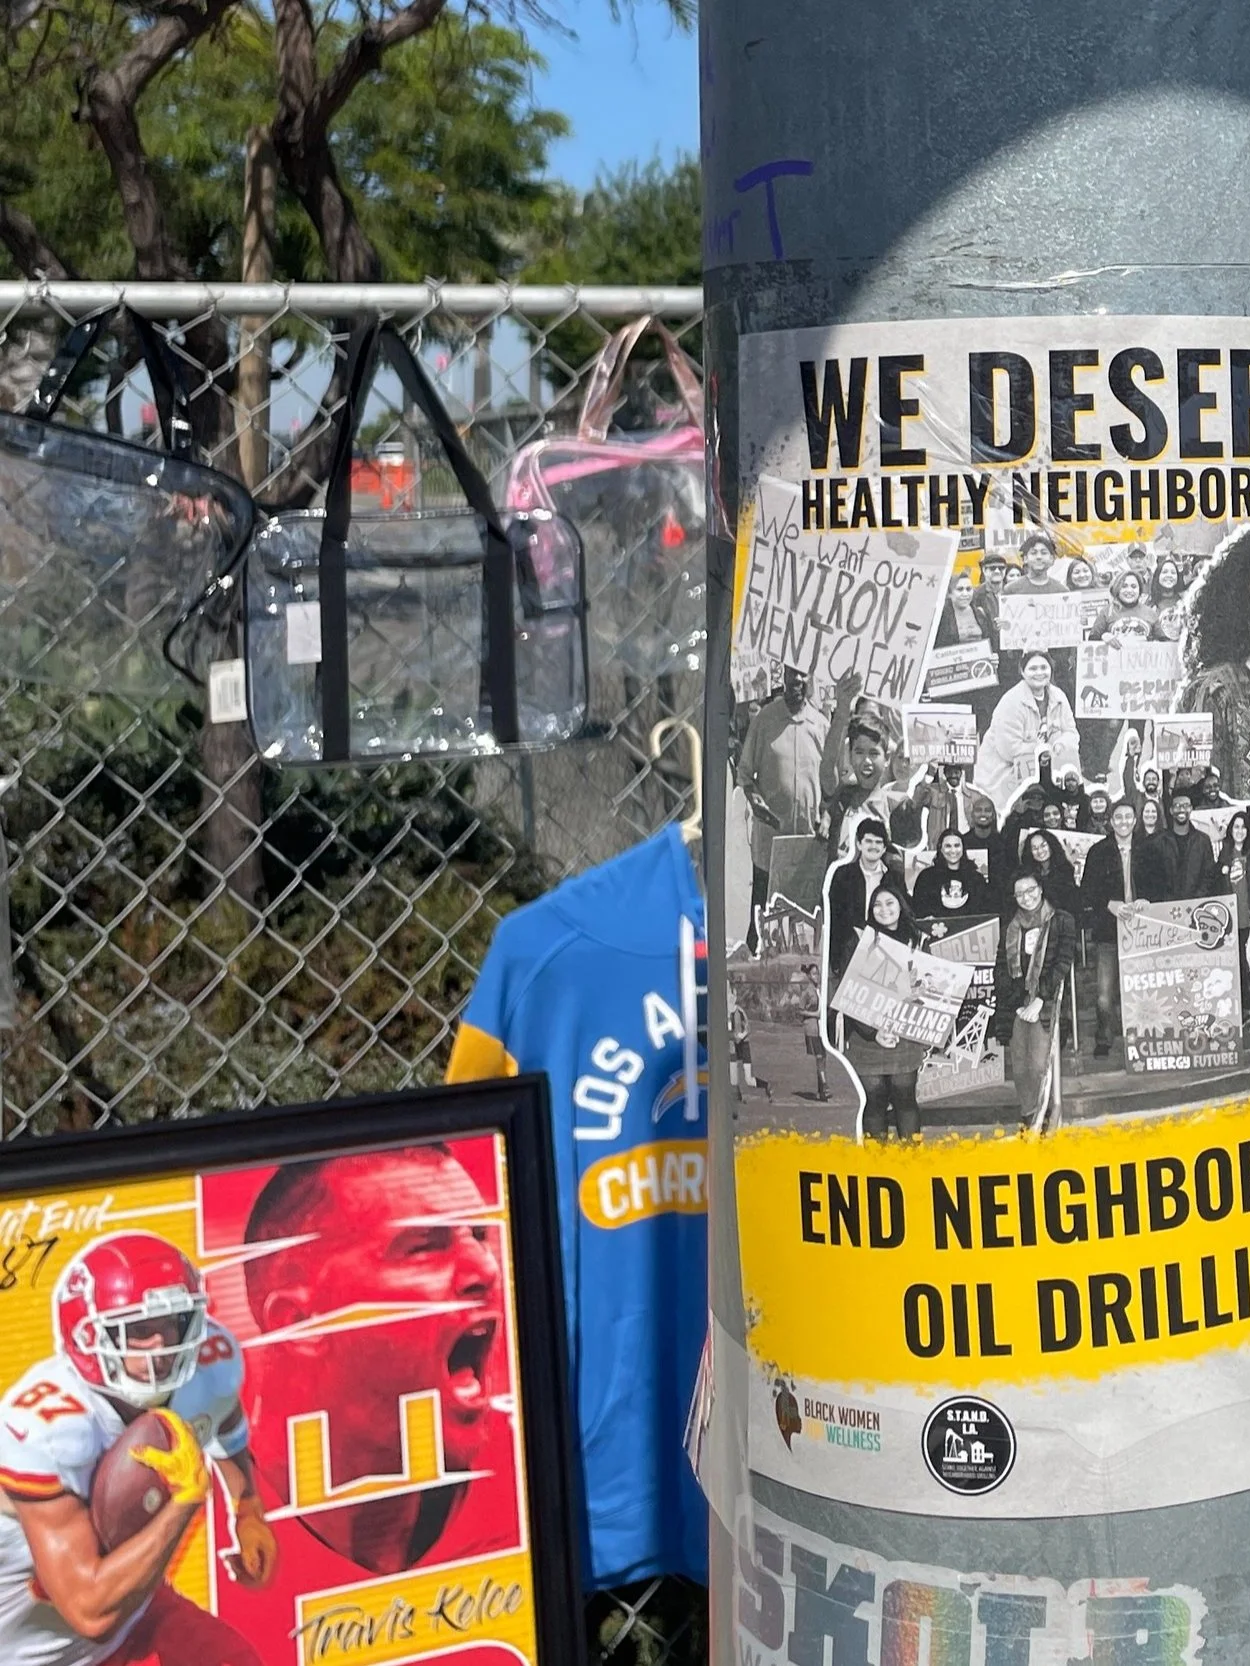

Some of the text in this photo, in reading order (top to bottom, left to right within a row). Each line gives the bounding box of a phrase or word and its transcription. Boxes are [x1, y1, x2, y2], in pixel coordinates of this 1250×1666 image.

[800, 354, 926, 470] WE
[759, 486, 799, 549] We
[802, 473, 992, 530] HEALTHY
[819, 536, 870, 574] want
[1123, 968, 1185, 993] DESERVE
[842, 979, 870, 1005] NO
[871, 992, 952, 1033] DRILLING
[906, 1023, 943, 1044] LIVING
[1127, 1040, 1184, 1061] A CLEAN
[1146, 1051, 1239, 1071] ENERGY FUTURE!
[573, 1037, 645, 1141] LOS
[597, 1152, 708, 1220] CHAR
[799, 1171, 906, 1249] END
[38, 1194, 115, 1240] End
[903, 1282, 1012, 1359] OIL
[11, 1380, 88, 1423] 87
[804, 1397, 836, 1424] BLACK
[838, 1406, 880, 1431] WOMEN
[826, 1423, 881, 1452] WELLNESS
[288, 1577, 522, 1664] Travis Kelce
